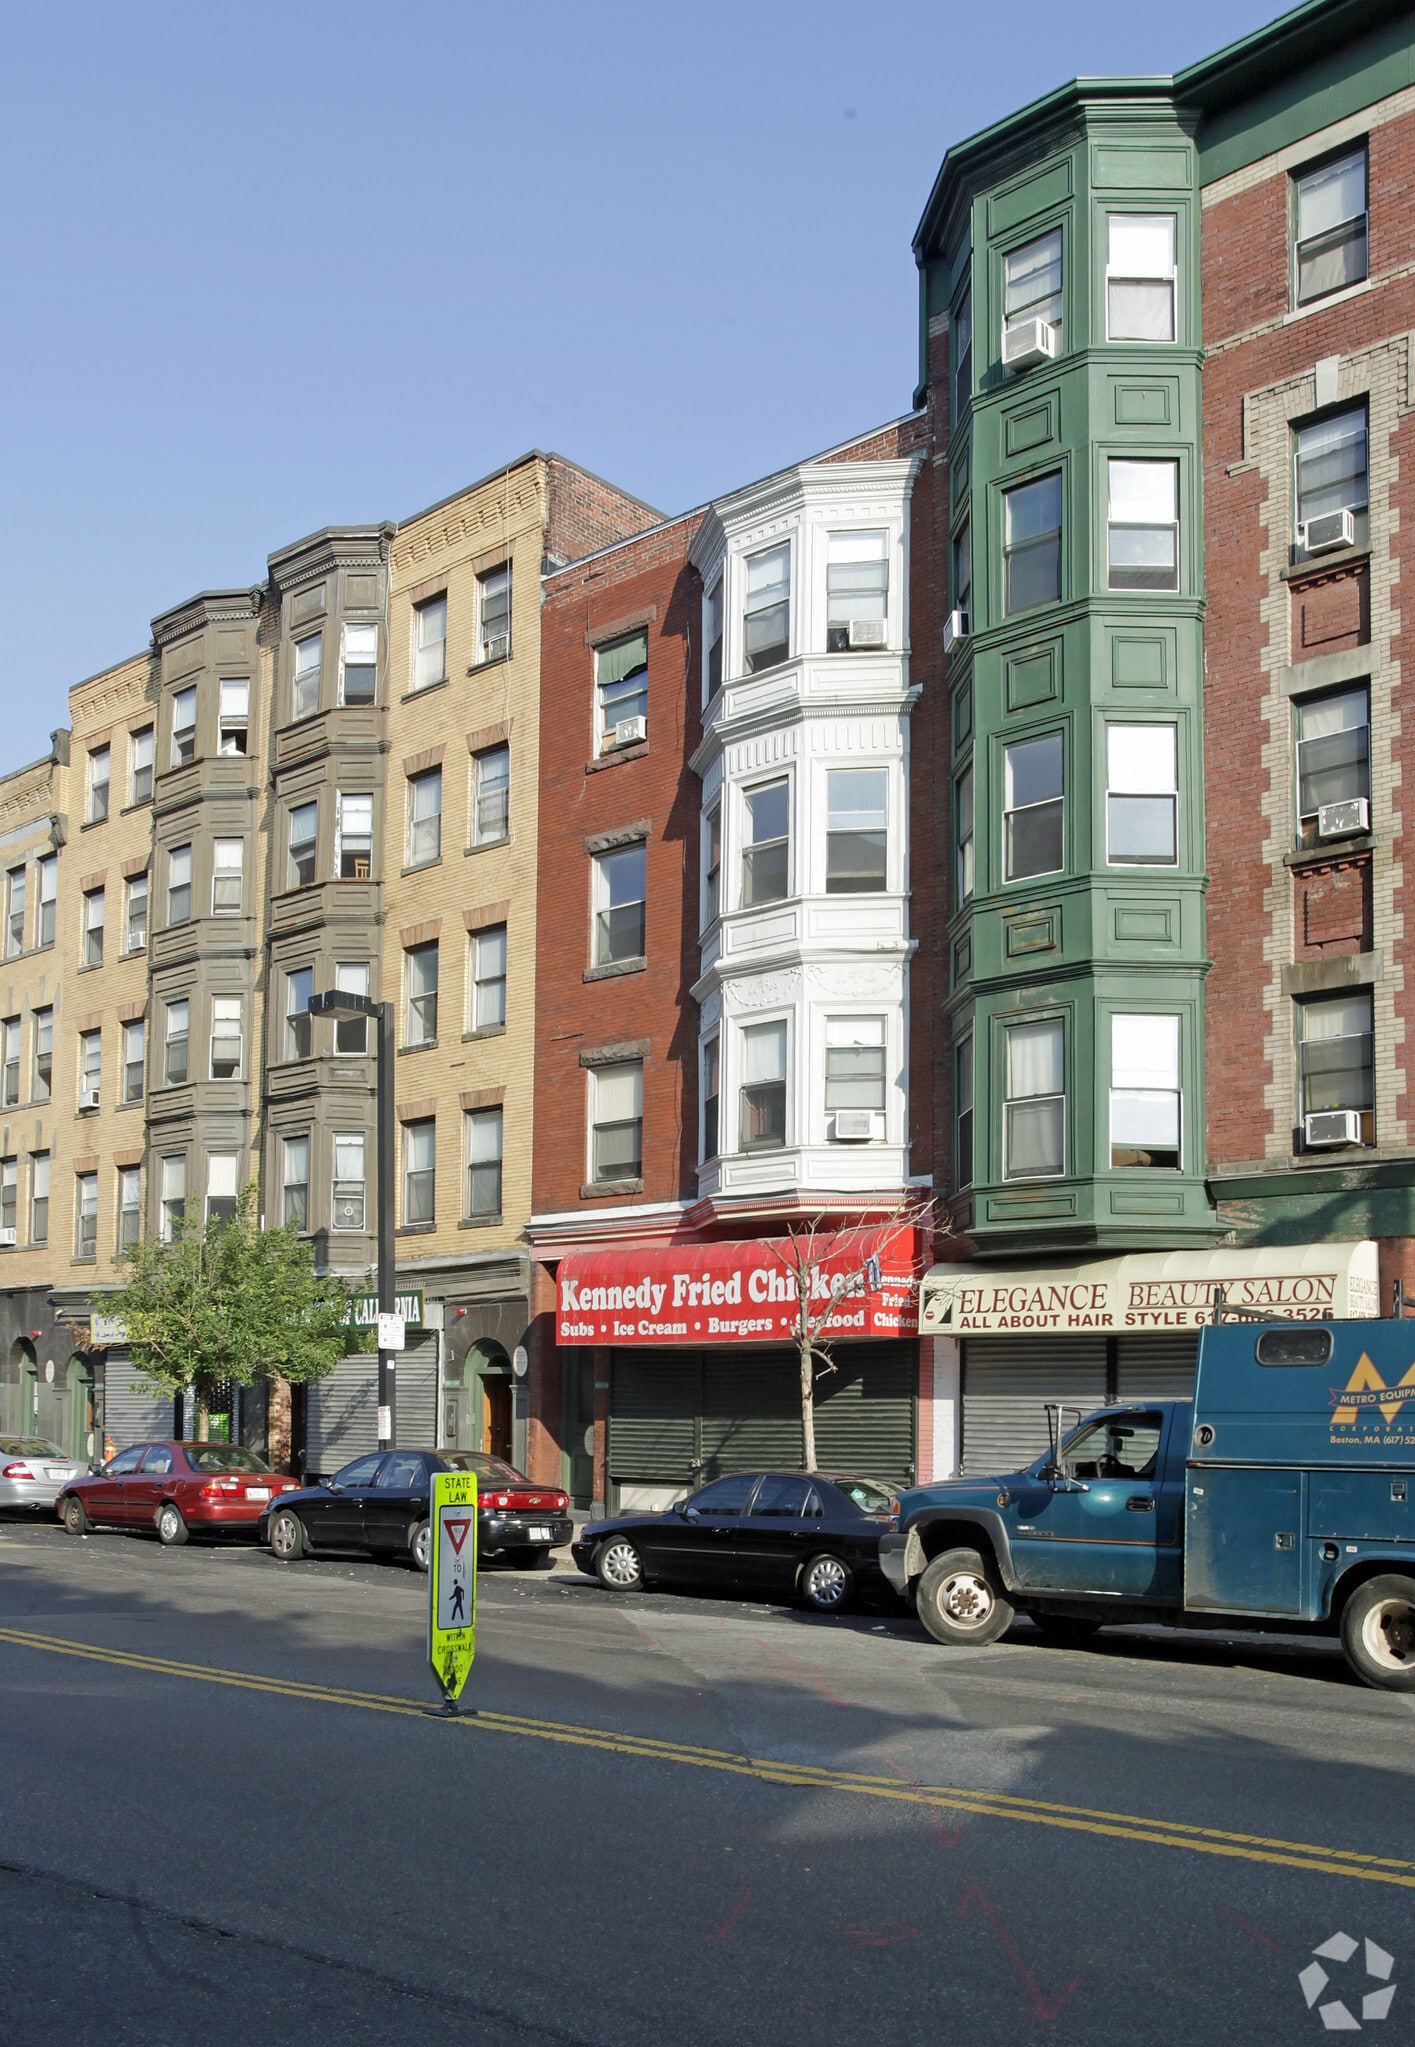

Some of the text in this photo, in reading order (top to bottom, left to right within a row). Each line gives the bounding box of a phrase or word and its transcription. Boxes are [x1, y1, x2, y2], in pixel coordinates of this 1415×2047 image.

[561, 1265, 866, 1315] Kennedy Fried Chicken
[958, 1277, 1337, 1314] ELEGANCE BEAUTY SALON
[874, 1312, 917, 1328] Chicken
[960, 1316, 991, 1328] ALL
[998, 1314, 1060, 1328] ABOUT
[1068, 1313, 1113, 1327] HAIR
[1125, 1311, 1187, 1325] STYLE
[561, 1321, 594, 1337] Subs
[613, 1320, 635, 1336] Ice
[638, 1319, 687, 1336] Cream
[708, 1317, 773, 1335] Burgers
[1340, 1394, 1377, 1404] METRO
[1330, 1435, 1362, 1444] Boston,
[1364, 1435, 1380, 1444] MA
[1383, 1435, 1403, 1445] (617)
[444, 1477, 471, 1489] STATE
[448, 1491, 467, 1503] LAW
[453, 1564, 462, 1573] TO
[437, 1642, 472, 1655] CROSSWALK
